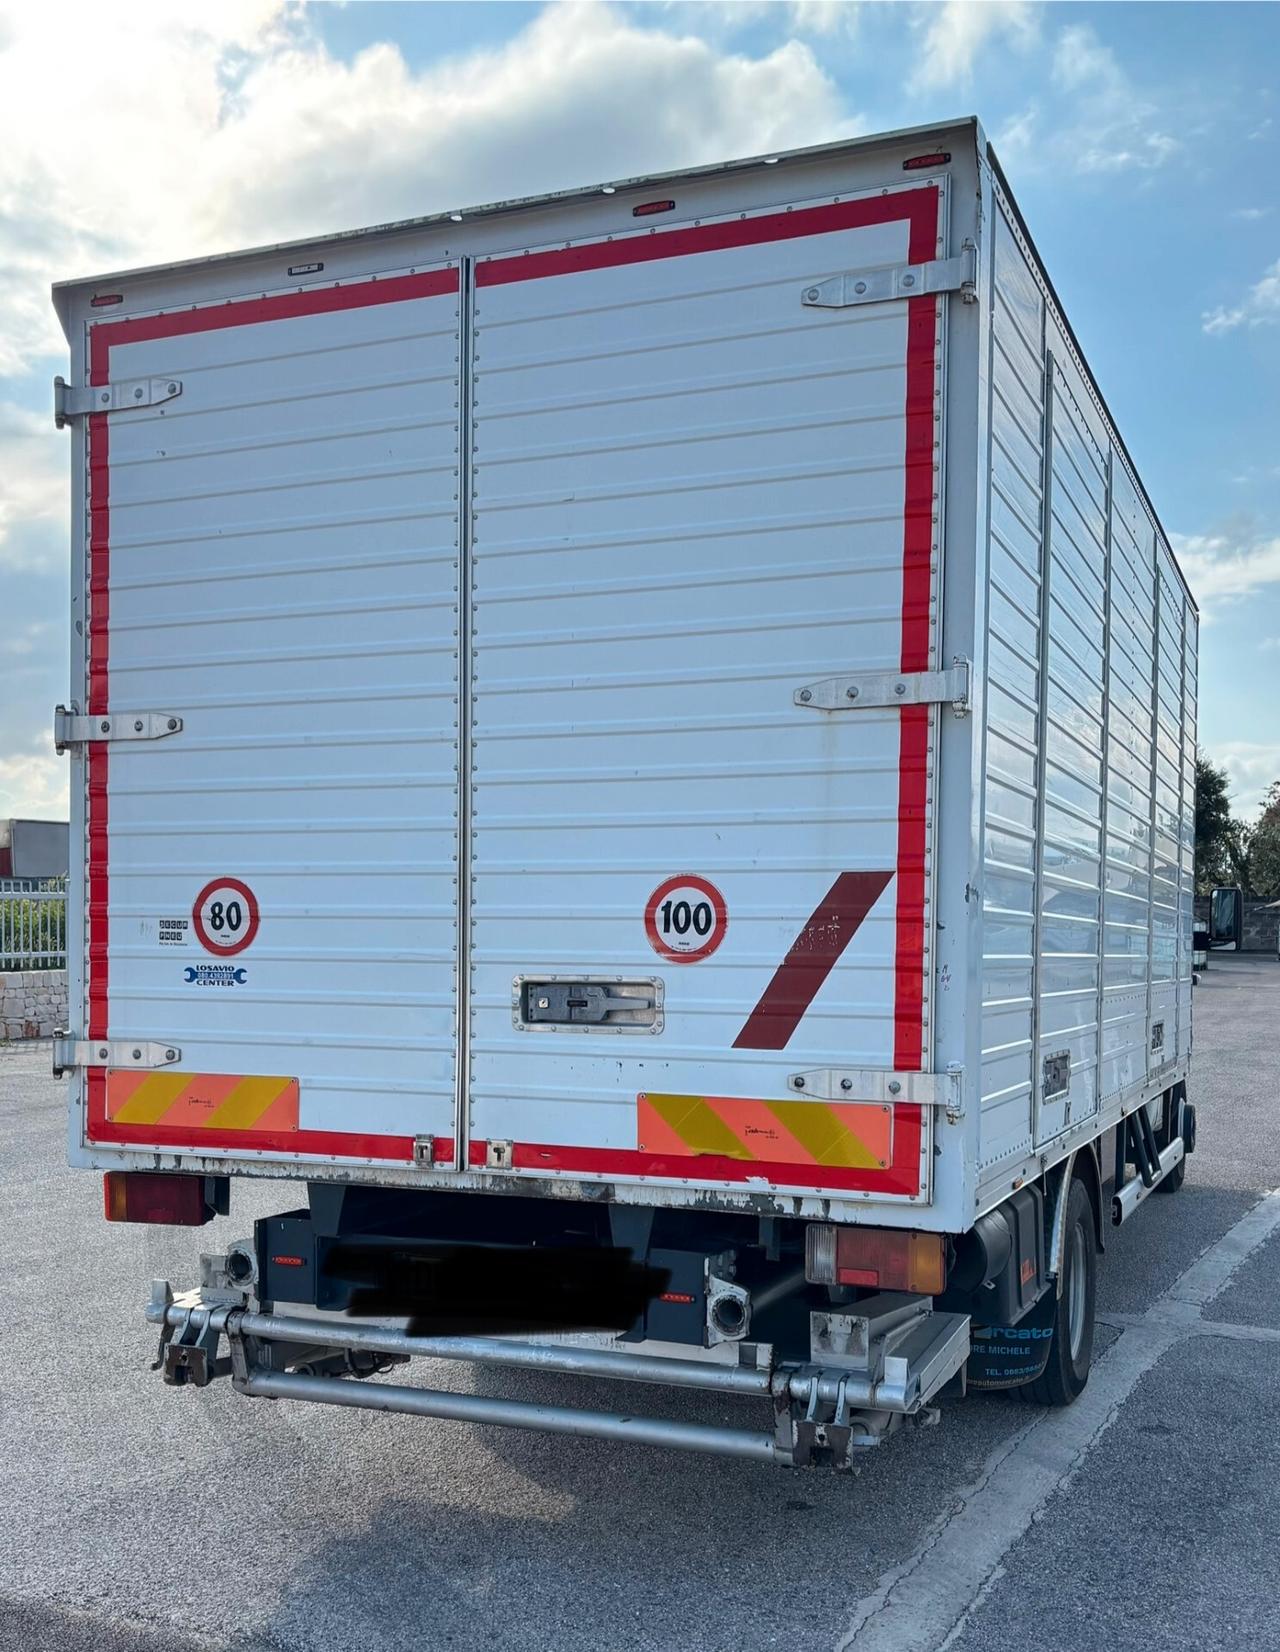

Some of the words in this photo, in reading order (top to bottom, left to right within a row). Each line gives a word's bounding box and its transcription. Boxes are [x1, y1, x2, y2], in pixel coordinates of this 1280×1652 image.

[211, 902, 242, 931] 80
[661, 900, 712, 936] 100
[159, 932, 182, 940] PNEU
[990, 1327, 1053, 1339] rcato
[969, 1344, 986, 1354] RE
[988, 1345, 1031, 1355] MICHELE
